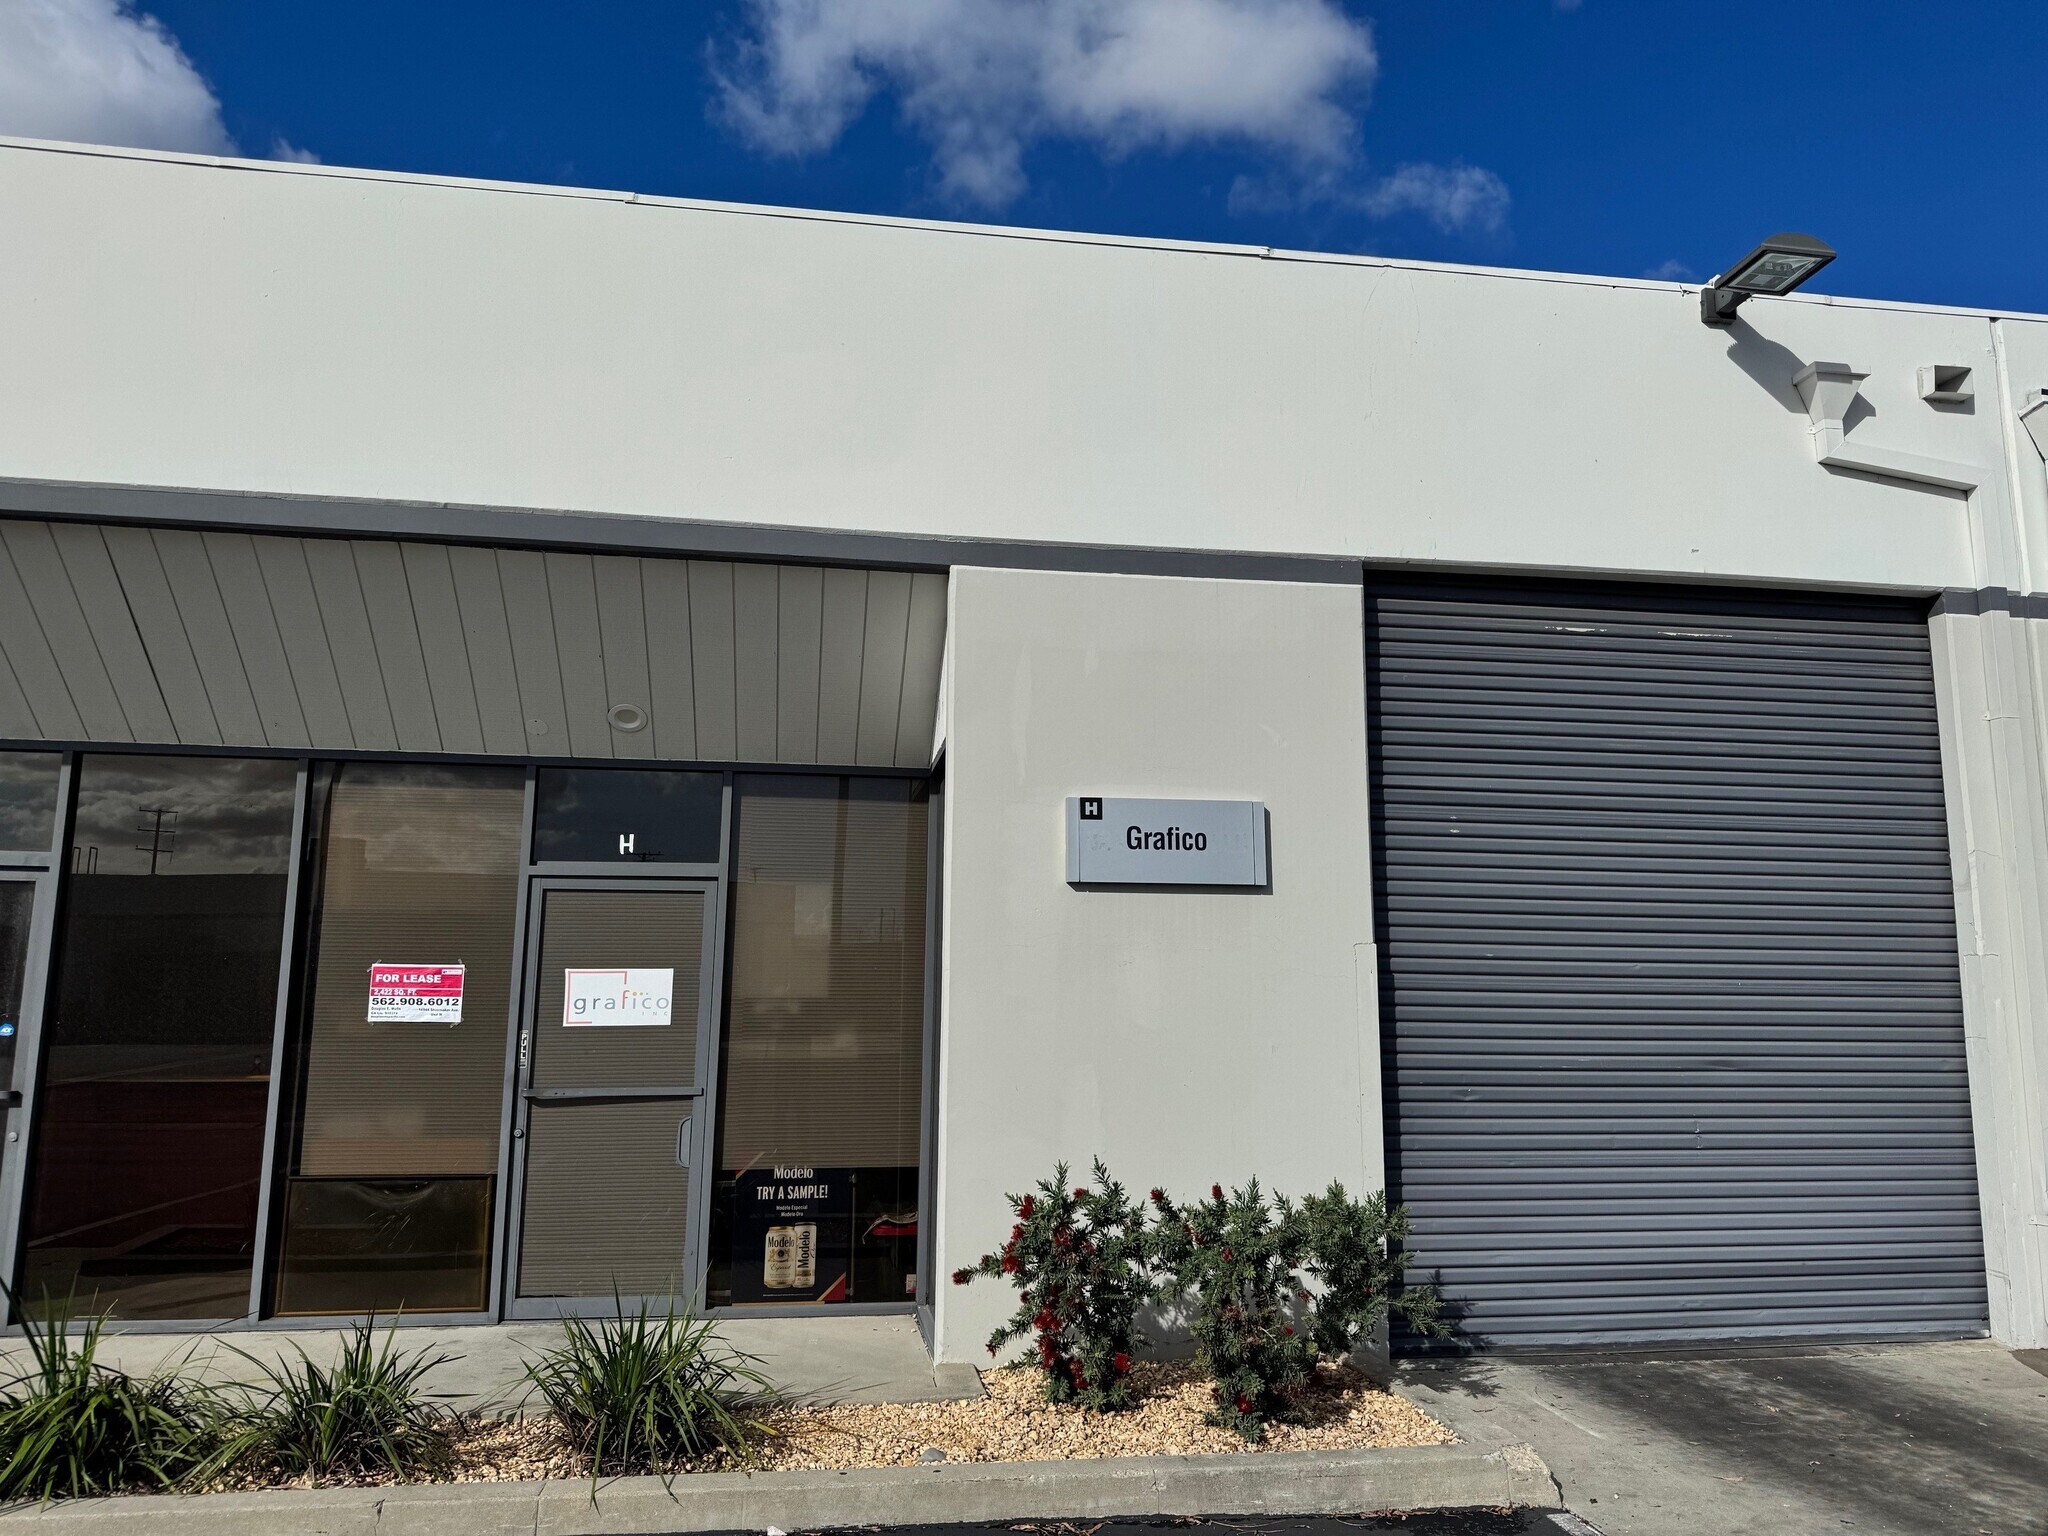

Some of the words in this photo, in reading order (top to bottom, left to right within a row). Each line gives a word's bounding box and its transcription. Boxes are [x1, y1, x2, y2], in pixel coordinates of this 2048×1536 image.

[1085, 801, 1098, 816] H
[619, 833, 635, 855] H
[1126, 825, 1207, 851] Grafico
[375, 973, 400, 983] FOR
[403, 974, 442, 984] LEASE
[374, 988, 393, 996] 2,422
[394, 988, 406, 996] SQ.
[407, 988, 417, 996] FT.
[372, 997, 459, 1006] 562.908.6012
[573, 989, 670, 1015] grafico
[773, 1165, 814, 1180] Modelo
[757, 1186, 776, 1200] TRY
[777, 1186, 785, 1200] A
[787, 1185, 829, 1199] SAMPLE!
[768, 1236, 795, 1249] Modelo
[797, 1230, 811, 1269] Modelo
